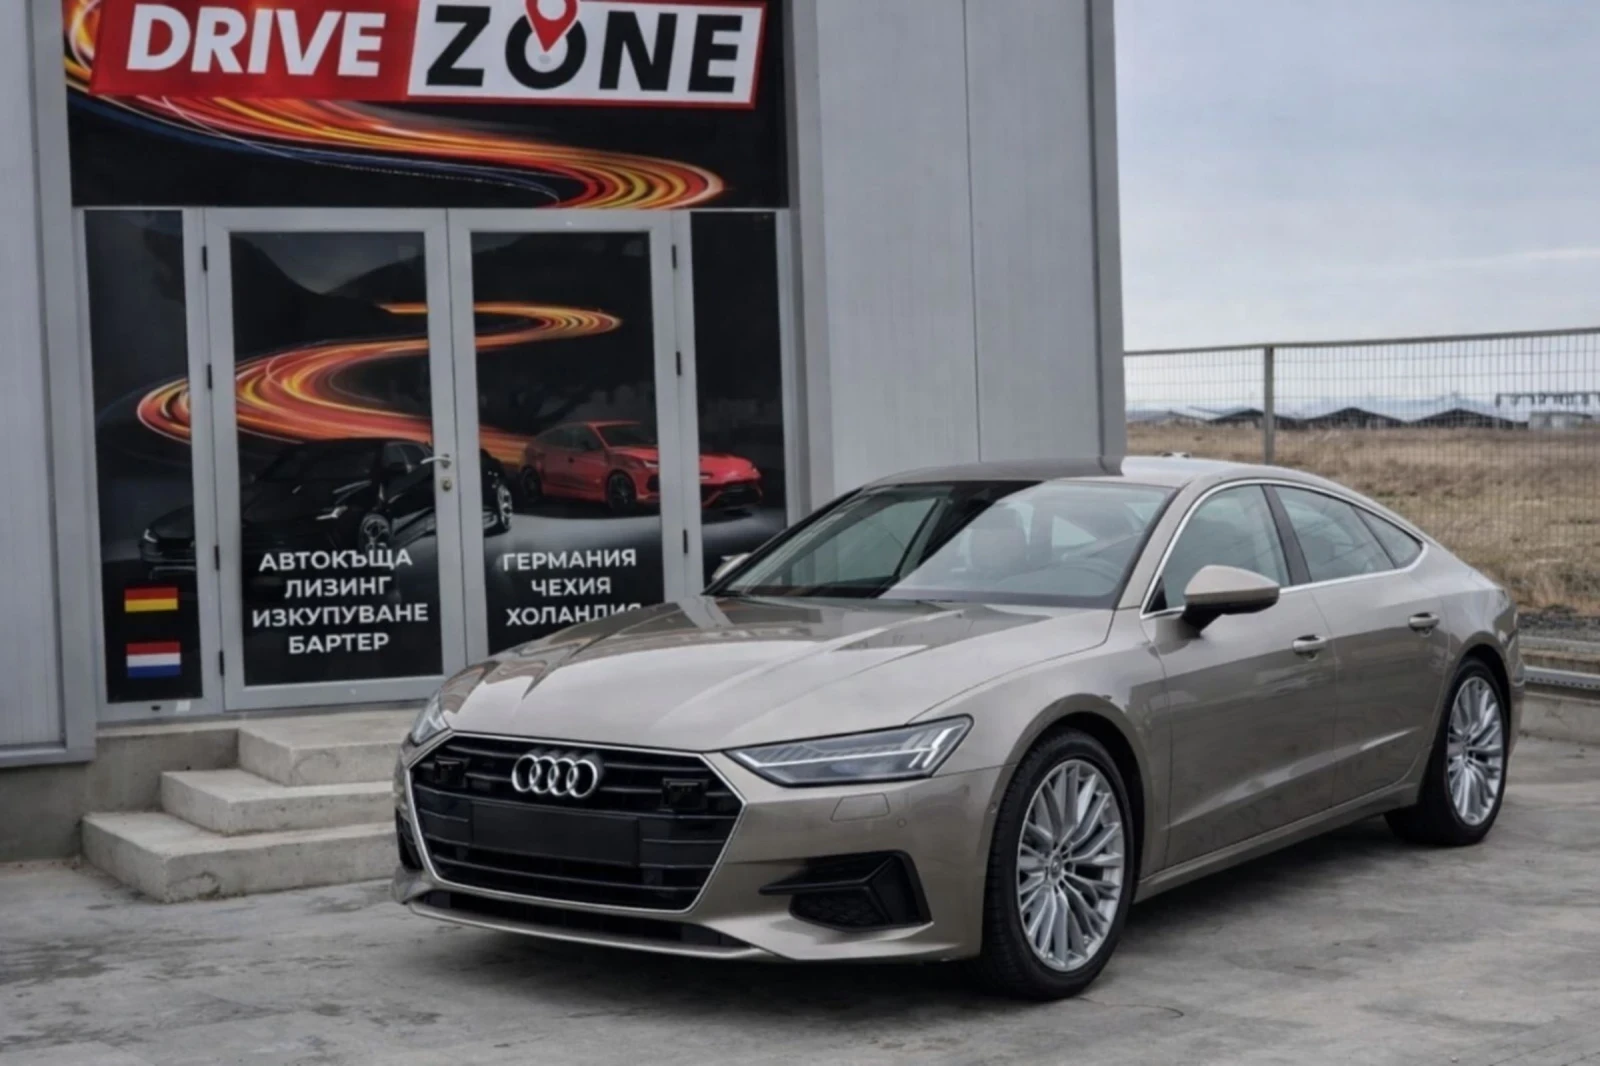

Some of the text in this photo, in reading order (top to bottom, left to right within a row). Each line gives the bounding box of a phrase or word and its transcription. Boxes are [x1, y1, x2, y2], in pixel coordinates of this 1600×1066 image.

[127, 4, 744, 92] DRIVE ZONE
[259, 548, 413, 571] АВТОКЪЩА
[502, 548, 636, 571] ГЕРМАНИЯ
[285, 576, 391, 598] ЛИЗИНГ
[531, 577, 611, 596] ЧЕХИЯ
[252, 603, 429, 627] ИЗКУПУВАНЕ
[288, 632, 389, 654] БАРТЕР
